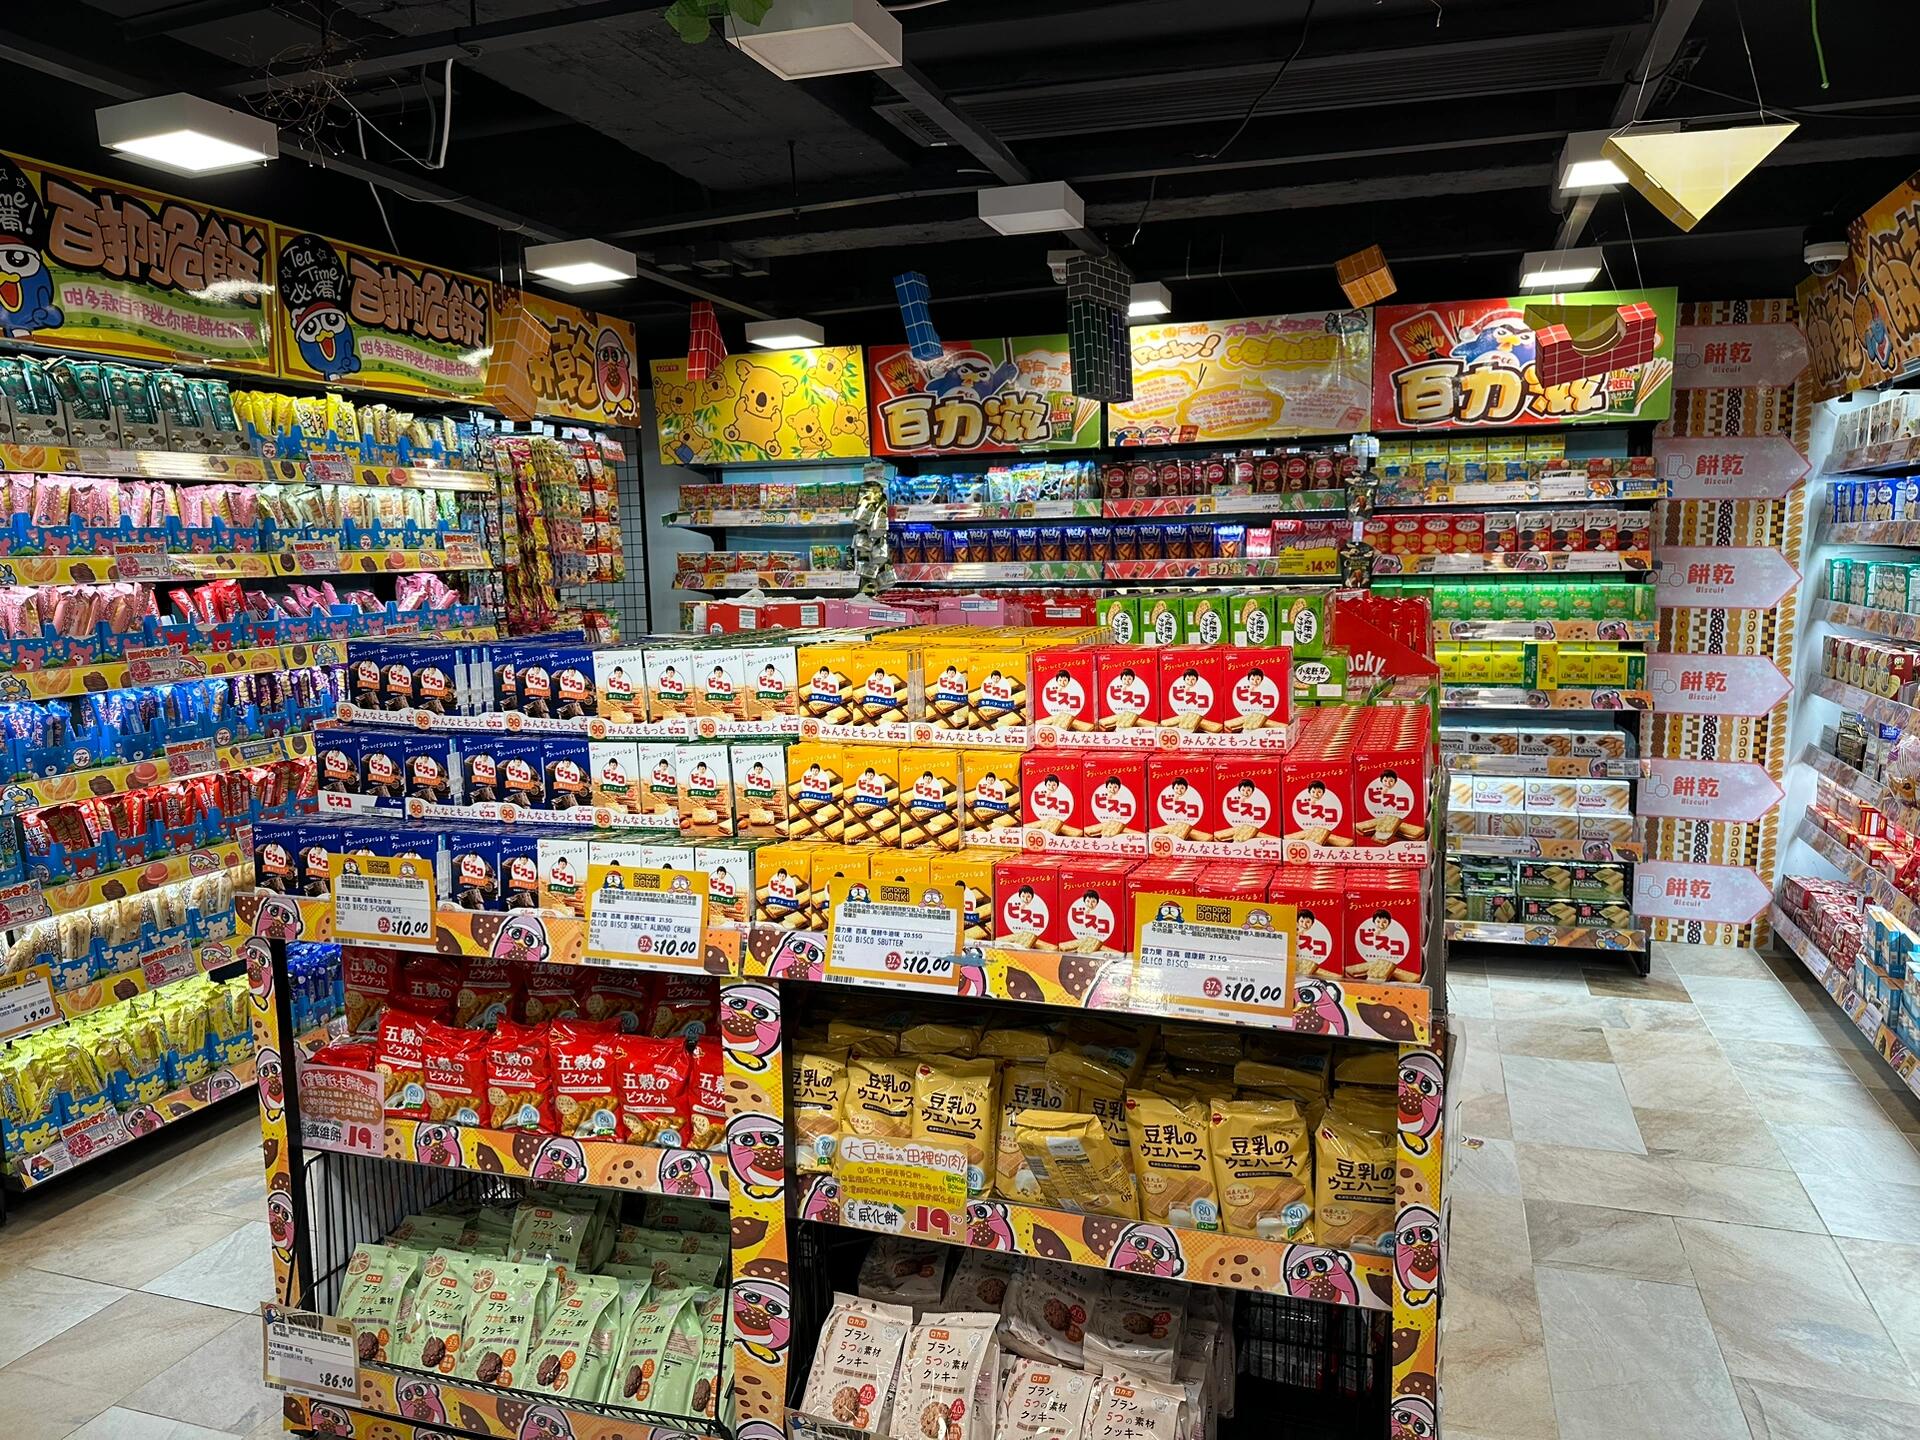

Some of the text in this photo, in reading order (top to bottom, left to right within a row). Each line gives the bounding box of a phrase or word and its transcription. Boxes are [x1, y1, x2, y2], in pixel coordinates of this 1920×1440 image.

[283, 246, 315, 273] Tea
[299, 265, 339, 290] Time
[1133, 334, 1221, 366] Pocky!
[1704, 343, 1751, 364] 餅乾
[1713, 366, 1741, 374] Biscuit
[1607, 379, 1634, 392] PRETZ
[882, 391, 1050, 446] 百力滋
[1050, 411, 1073, 423] PRETZ
[1696, 454, 1743, 476] 餅乾
[1704, 477, 1733, 486] Biscuit
[1487, 518, 1517, 527] ノアール
[1522, 518, 1546, 527] ノアール
[1554, 517, 1579, 526] ノアール
[1586, 516, 1614, 526] ノアール
[1621, 517, 1646, 527] ノアール
[1306, 559, 1337, 573] $14.90
[1687, 563, 1735, 585] 餅乾
[1696, 586, 1725, 594] Biscuit
[360, 666, 381, 682] ビスコ
[389, 670, 410, 686] ビスコ
[1298, 667, 1330, 676] 小麦胚芽の
[1300, 674, 1326, 682] クラッカー
[424, 673, 445, 689] ビスコ
[528, 673, 550, 689] ビスコ
[562, 674, 584, 691] ビスコ
[609, 677, 630, 693] ビスコ
[661, 677, 683, 692] ビスコ
[708, 677, 731, 692] ビスコ
[759, 676, 783, 691] ビスコ
[813, 677, 837, 694] ビスコ
[868, 680, 892, 696] ビスコ
[940, 677, 967, 694] ビスコ
[1680, 671, 1728, 692] 餅乾
[983, 681, 1009, 698] ビスコ
[1689, 693, 1717, 701] Biscuit
[1045, 686, 1081, 709] ビスコ
[340, 708, 404, 722] 90 みんなともっと
[431, 715, 484, 727] みんなともっと
[523, 718, 577, 730] みんなともっと
[607, 725, 665, 736] みんなともっと
[718, 723, 777, 735] みんなともっと
[821, 724, 884, 739] みんなともっと
[934, 730, 1002, 744] みんなともっと
[1059, 732, 1130, 746] みんなともっと
[1182, 734, 1258, 747] みんなともっと
[1468, 742, 1496, 752] D'asses
[1521, 743, 1549, 752] D'asses
[1574, 744, 1602, 754] D'asses
[1672, 776, 1720, 797] 餅乾
[1475, 791, 1503, 801] D'asses
[1528, 793, 1555, 802] D'asses
[1578, 794, 1607, 803] D'asses
[1682, 798, 1709, 806] Biscuit
[424, 805, 478, 818] みんなともっと
[518, 809, 573, 822] みんなともっと
[612, 814, 674, 826] みんなともっと
[1528, 825, 1557, 835] D'asses
[1581, 828, 1610, 837] D'asses
[1047, 838, 1119, 851] みんなともっと
[1521, 877, 1549, 886] D'asses
[1573, 878, 1602, 887] D'asses
[1666, 877, 1712, 899] 餅乾
[1674, 899, 1702, 907] Biscuit
[1526, 914, 1555, 923] D'asses
[391, 920, 429, 936] $10.00
[591, 919, 608, 927] GLICO
[610, 921, 627, 929] BISCO
[649, 924, 671, 932] ALMOND
[673, 925, 691, 934] CREAM
[653, 938, 696, 956] $10.00
[834, 935, 904, 947] GLICO BISCO SBUTTER
[349, 956, 389, 974] 五穀の
[902, 956, 951, 975] $10.00
[1141, 955, 1189, 968] GLICO BISCO
[1209, 954, 1228, 963] 21.5G
[532, 962, 575, 977] 五穀の
[350, 971, 387, 988] ビスケット
[532, 974, 572, 991] ビスケット
[411, 980, 453, 998] 五穀の
[1224, 982, 1281, 1004] $10.00
[23, 1006, 50, 1023] $9.90
[385, 1024, 424, 1048] 五穀の
[386, 1043, 424, 1061] ビスケット
[490, 1050, 534, 1069] 五穀の
[424, 1054, 466, 1073] 五穀の
[557, 1053, 607, 1073] 五穀の
[428, 1069, 466, 1086] ビスケット
[493, 1065, 535, 1083] ビスケット
[560, 1068, 605, 1087] ビスケット
[622, 1073, 670, 1092] 五穀の
[868, 1073, 911, 1094] 豆乳の
[625, 1088, 669, 1107] ビスケット
[857, 1087, 914, 1112] ウエハース
[1014, 1084, 1061, 1109] 豆乳の
[928, 1093, 977, 1116] 豆乳の
[920, 1109, 983, 1131] ウエハース
[1143, 1125, 1198, 1146] 豆乳の
[1139, 1143, 1208, 1163] ウエハース
[1230, 1136, 1290, 1157] 豆乳の
[1224, 1155, 1299, 1173] ウエハース
[1335, 1158, 1396, 1182] 豆乳の
[858, 1206, 898, 1226] 威化餅
[528, 1241, 560, 1252] クッキー
[354, 1305, 383, 1317] クッキー
[427, 1309, 454, 1321] クッキー
[483, 1324, 512, 1335] クッキー
[848, 1316, 866, 1328] ロカボ
[548, 1327, 573, 1337] クッキー
[929, 1329, 948, 1340] ロカボ
[632, 1336, 653, 1347] クッキー
[839, 1341, 882, 1358] 5つの素材
[836, 1354, 869, 1369] クッキー
[923, 1355, 970, 1373] 5つの素材
[923, 1368, 958, 1382] クッキー
[1031, 1374, 1051, 1384] ロカボ
[1114, 1387, 1134, 1397] ロカボ
[1023, 1397, 1068, 1412] 5つの素材
[1020, 1410, 1056, 1424] クッキー
[1105, 1411, 1155, 1430] 5つの素材
[1103, 1424, 1144, 1439] クッキー
